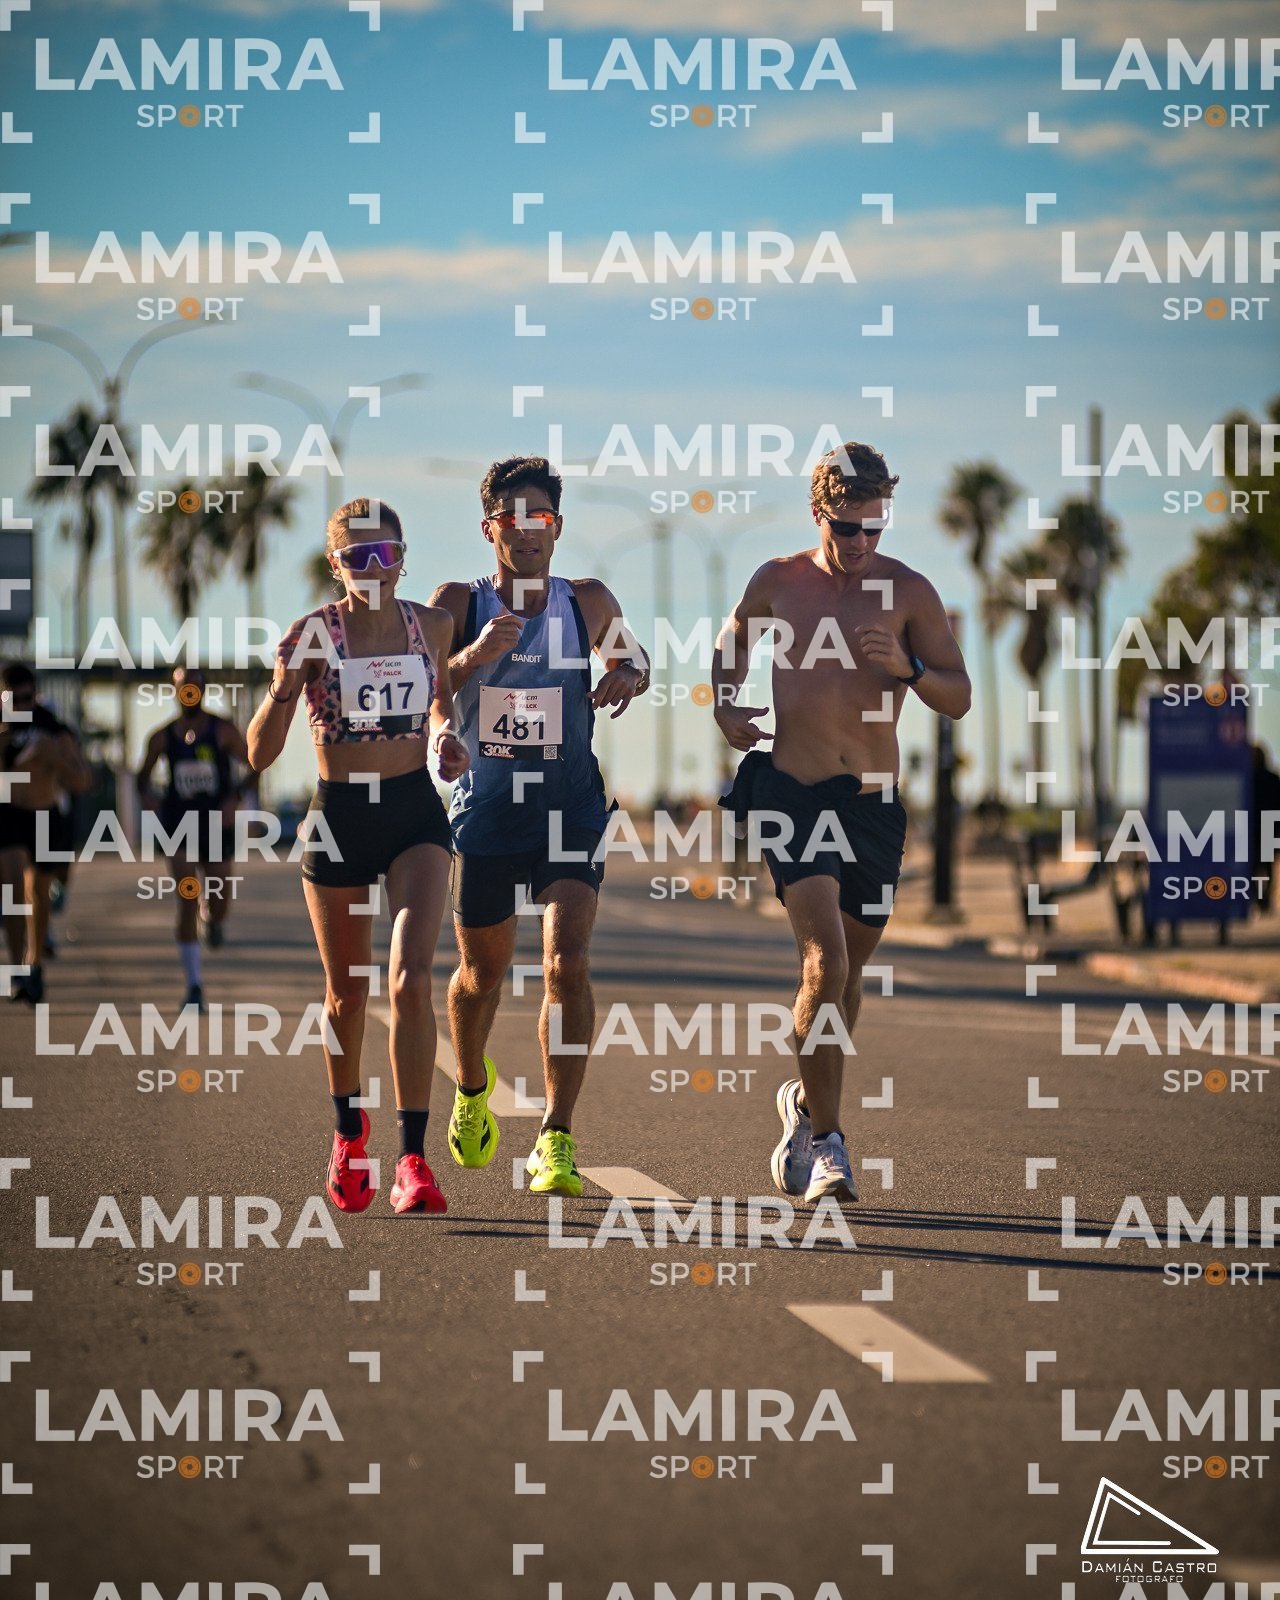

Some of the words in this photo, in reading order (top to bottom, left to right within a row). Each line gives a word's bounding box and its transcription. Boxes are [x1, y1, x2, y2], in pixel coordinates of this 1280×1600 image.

[511, 653, 542, 663] BANDIT
[357, 682, 414, 711] 617
[493, 714, 544, 740] 481
[483, 744, 512, 757] 30K
